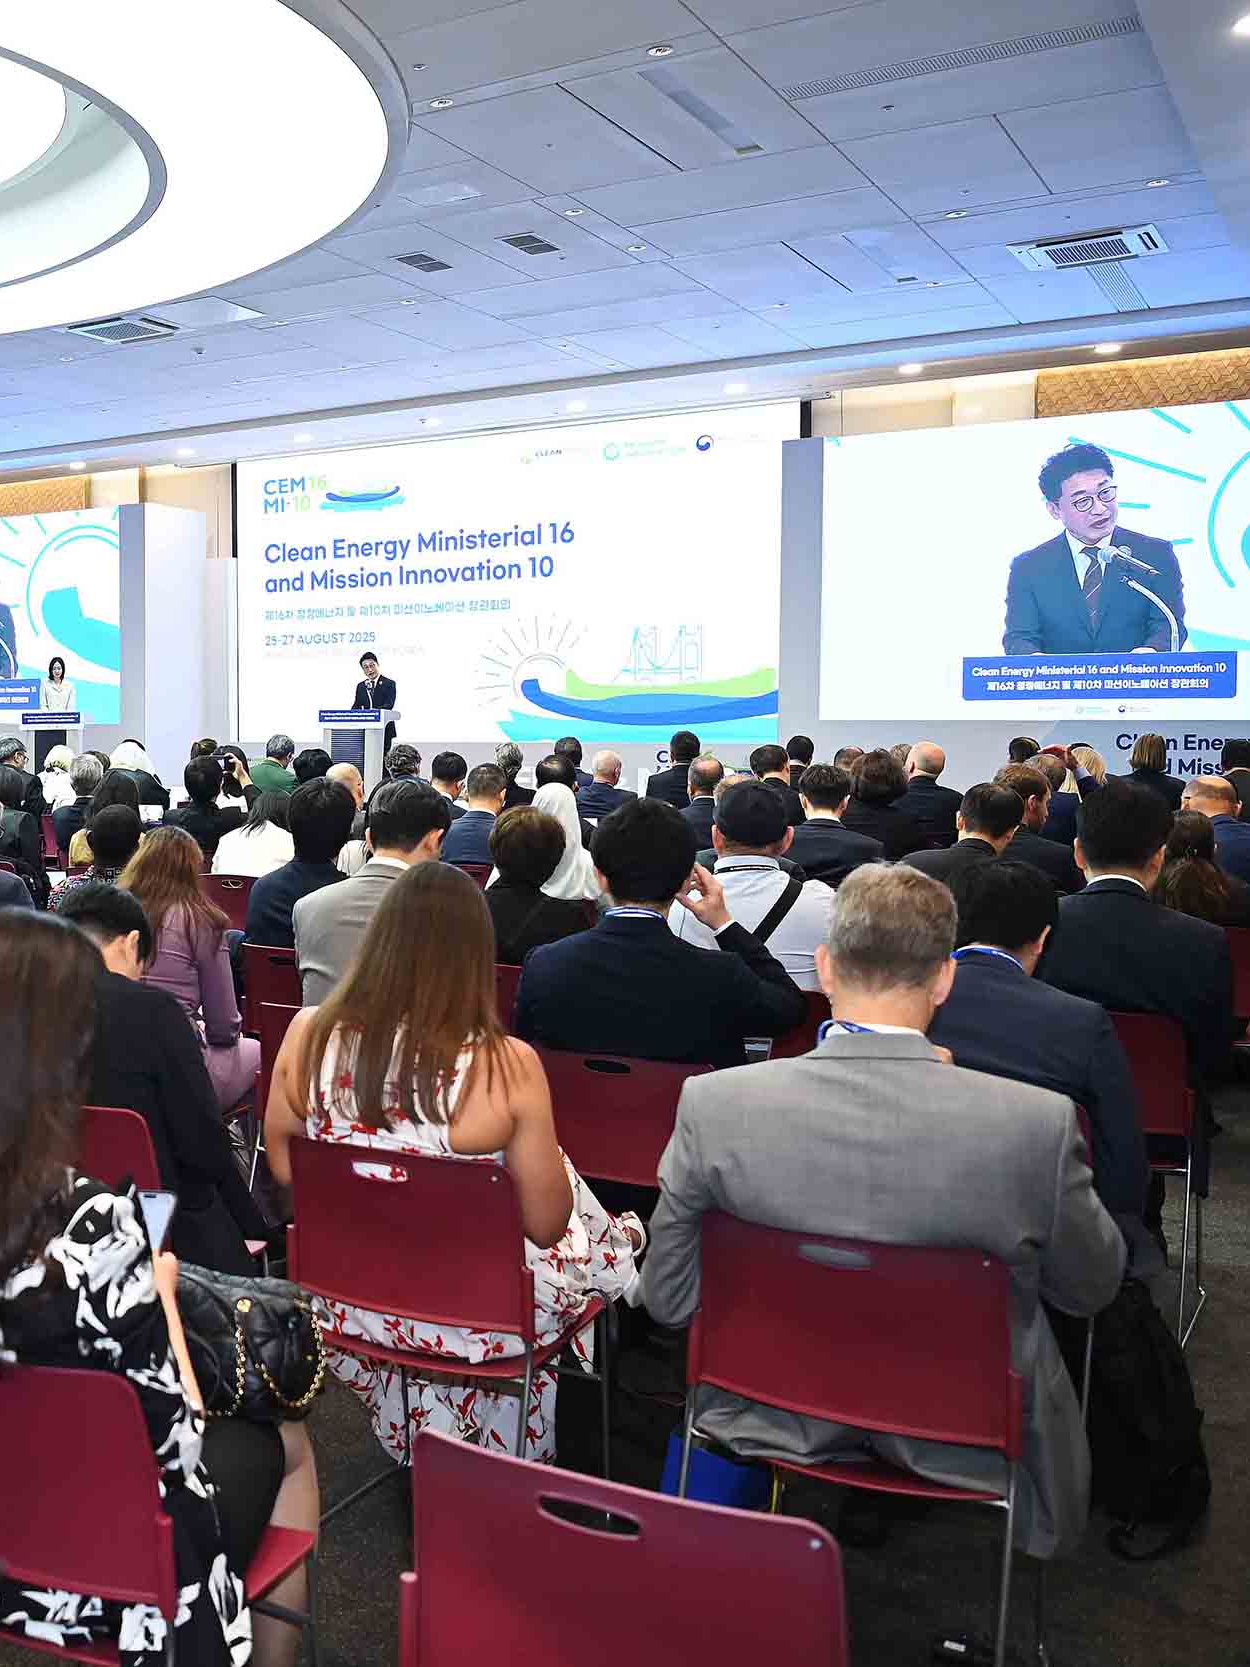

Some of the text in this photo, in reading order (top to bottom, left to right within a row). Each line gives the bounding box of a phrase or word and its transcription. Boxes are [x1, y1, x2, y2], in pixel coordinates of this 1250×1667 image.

[264, 521, 575, 563] Clean Energy Ministerial 16
[265, 555, 554, 593] and Mission Innovation 10
[297, 632, 346, 645] AUGUST
[349, 631, 376, 643] 2025
[972, 662, 1227, 678] Clean Energy Ministerial 16 and Mission Innovation 10
